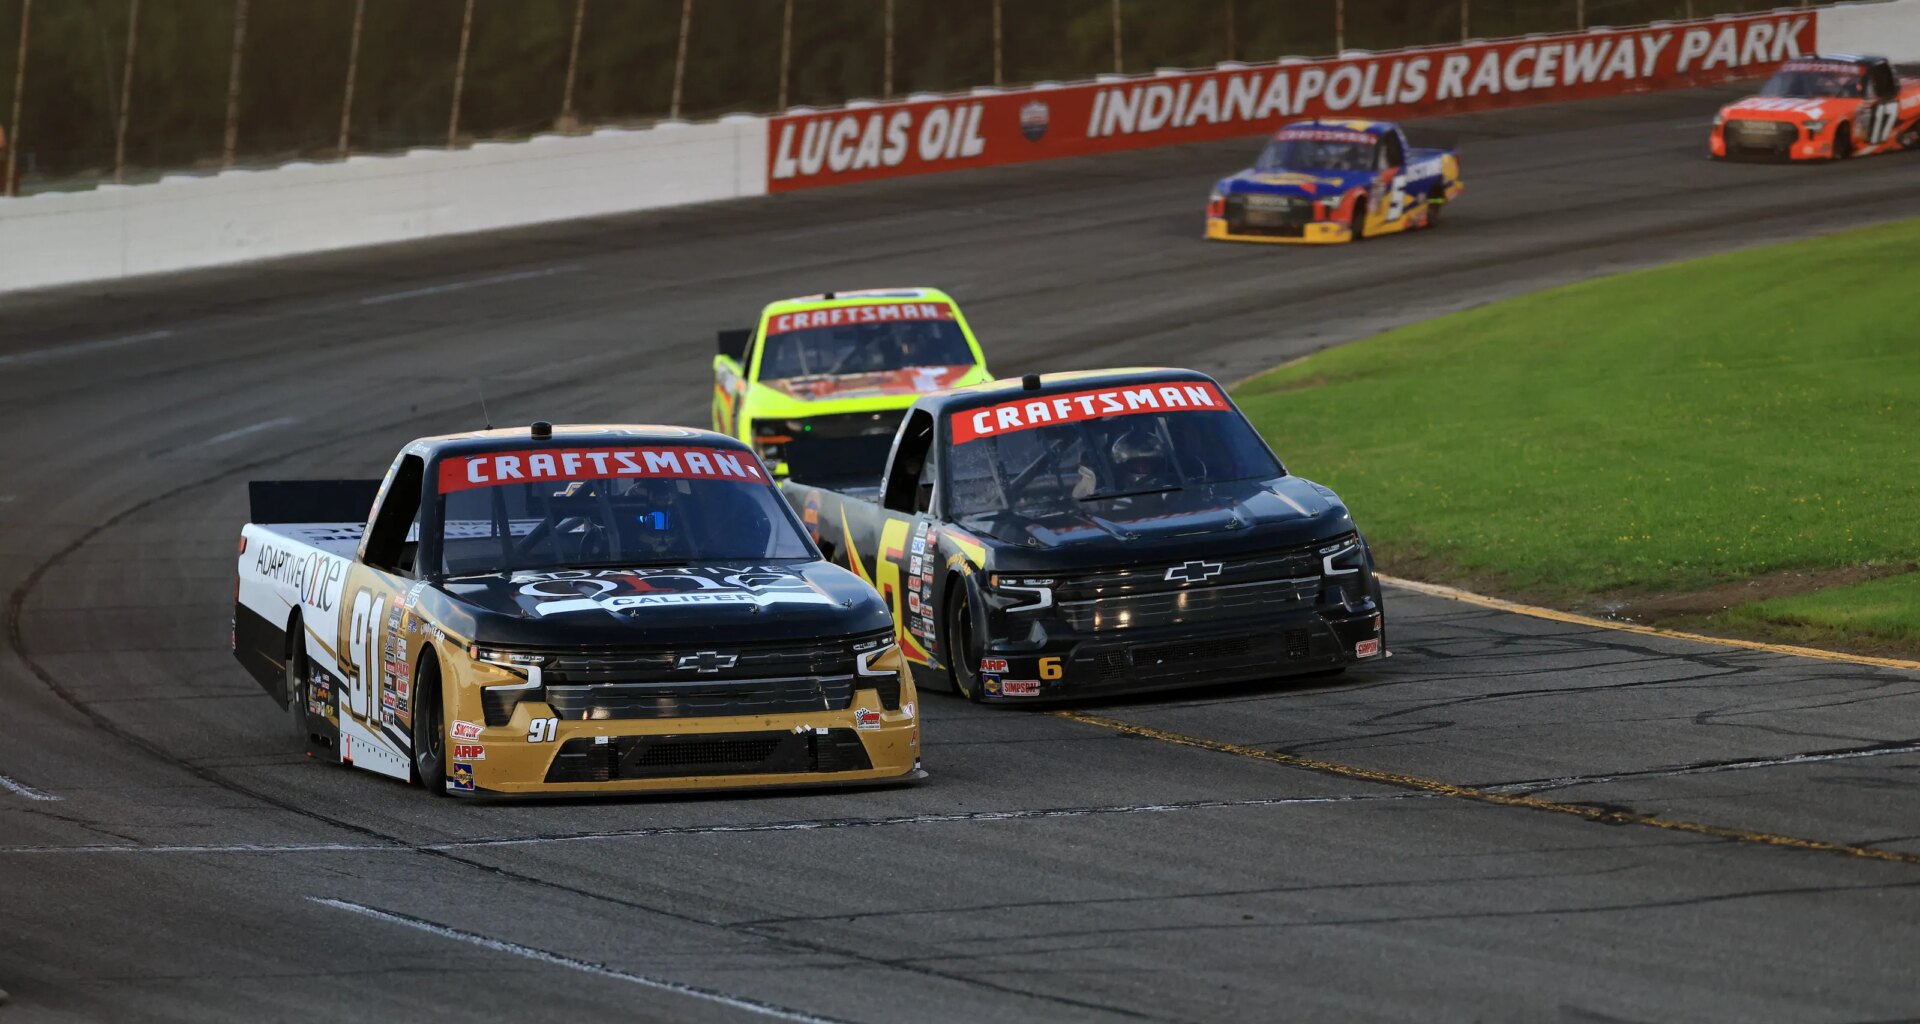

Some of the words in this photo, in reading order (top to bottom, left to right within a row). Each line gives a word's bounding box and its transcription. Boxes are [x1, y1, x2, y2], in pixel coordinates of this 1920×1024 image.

[1087, 56, 1431, 138] INDIANAPOLIS
[1436, 32, 1672, 101] RACEWAY
[1676, 17, 1809, 73] PARK
[1870, 101, 1899, 145] 17
[774, 110, 913, 180] LUCAS
[918, 103, 986, 160] OIL
[1386, 176, 1407, 221] 5
[777, 303, 938, 331] CRAFTSMAN
[972, 385, 1215, 435] CRAFTSMAN
[466, 450, 747, 484] CRAFTSMAN
[256, 543, 301, 588] ADAPTIVE
[612, 593, 757, 606] CALIPER
[349, 588, 387, 726] 91
[981, 659, 1007, 671] ARP
[1038, 656, 1063, 680] 6
[1004, 681, 1037, 693] SIMPSON
[527, 717, 559, 743] 91
[453, 745, 484, 758] ARP
